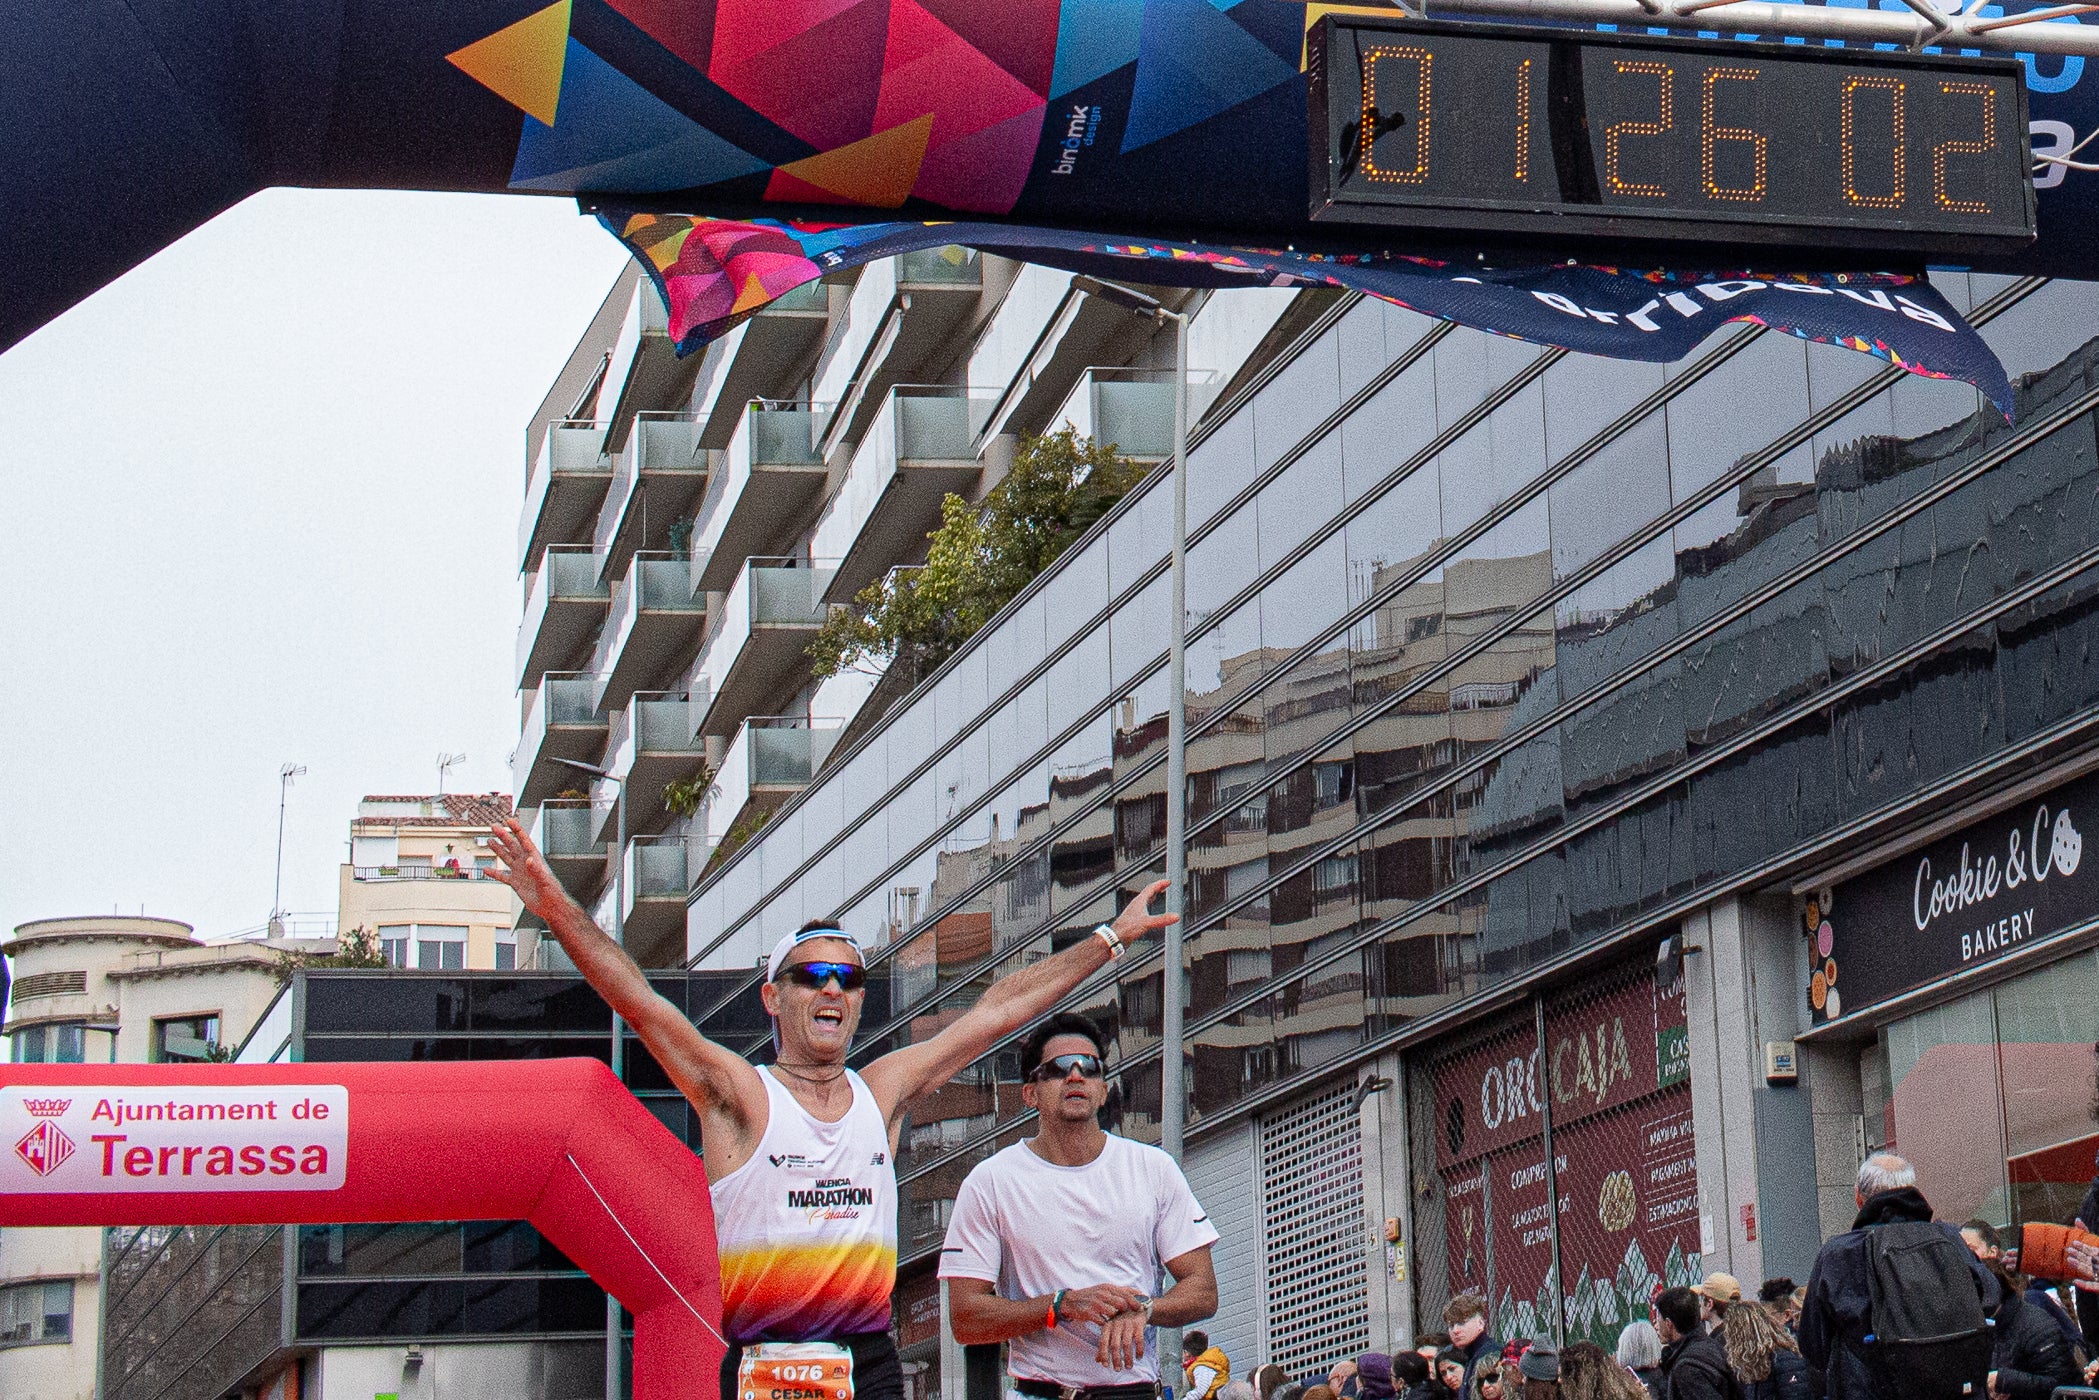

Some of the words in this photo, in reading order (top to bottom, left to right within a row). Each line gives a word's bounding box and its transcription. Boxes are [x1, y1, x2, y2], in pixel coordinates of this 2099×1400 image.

[1083, 105, 1102, 146] design
[1914, 842, 2001, 931] Cookie
[2005, 828, 2027, 889] &
[1961, 908, 2034, 961] BAKERY
[90, 1098, 278, 1127] Ajuntament
[291, 1098, 329, 1120] de
[91, 1134, 329, 1176] Terrassa
[788, 1187, 873, 1208] MARATHON
[771, 1365, 824, 1381] 1076
[771, 1388, 825, 1400] CESAR
